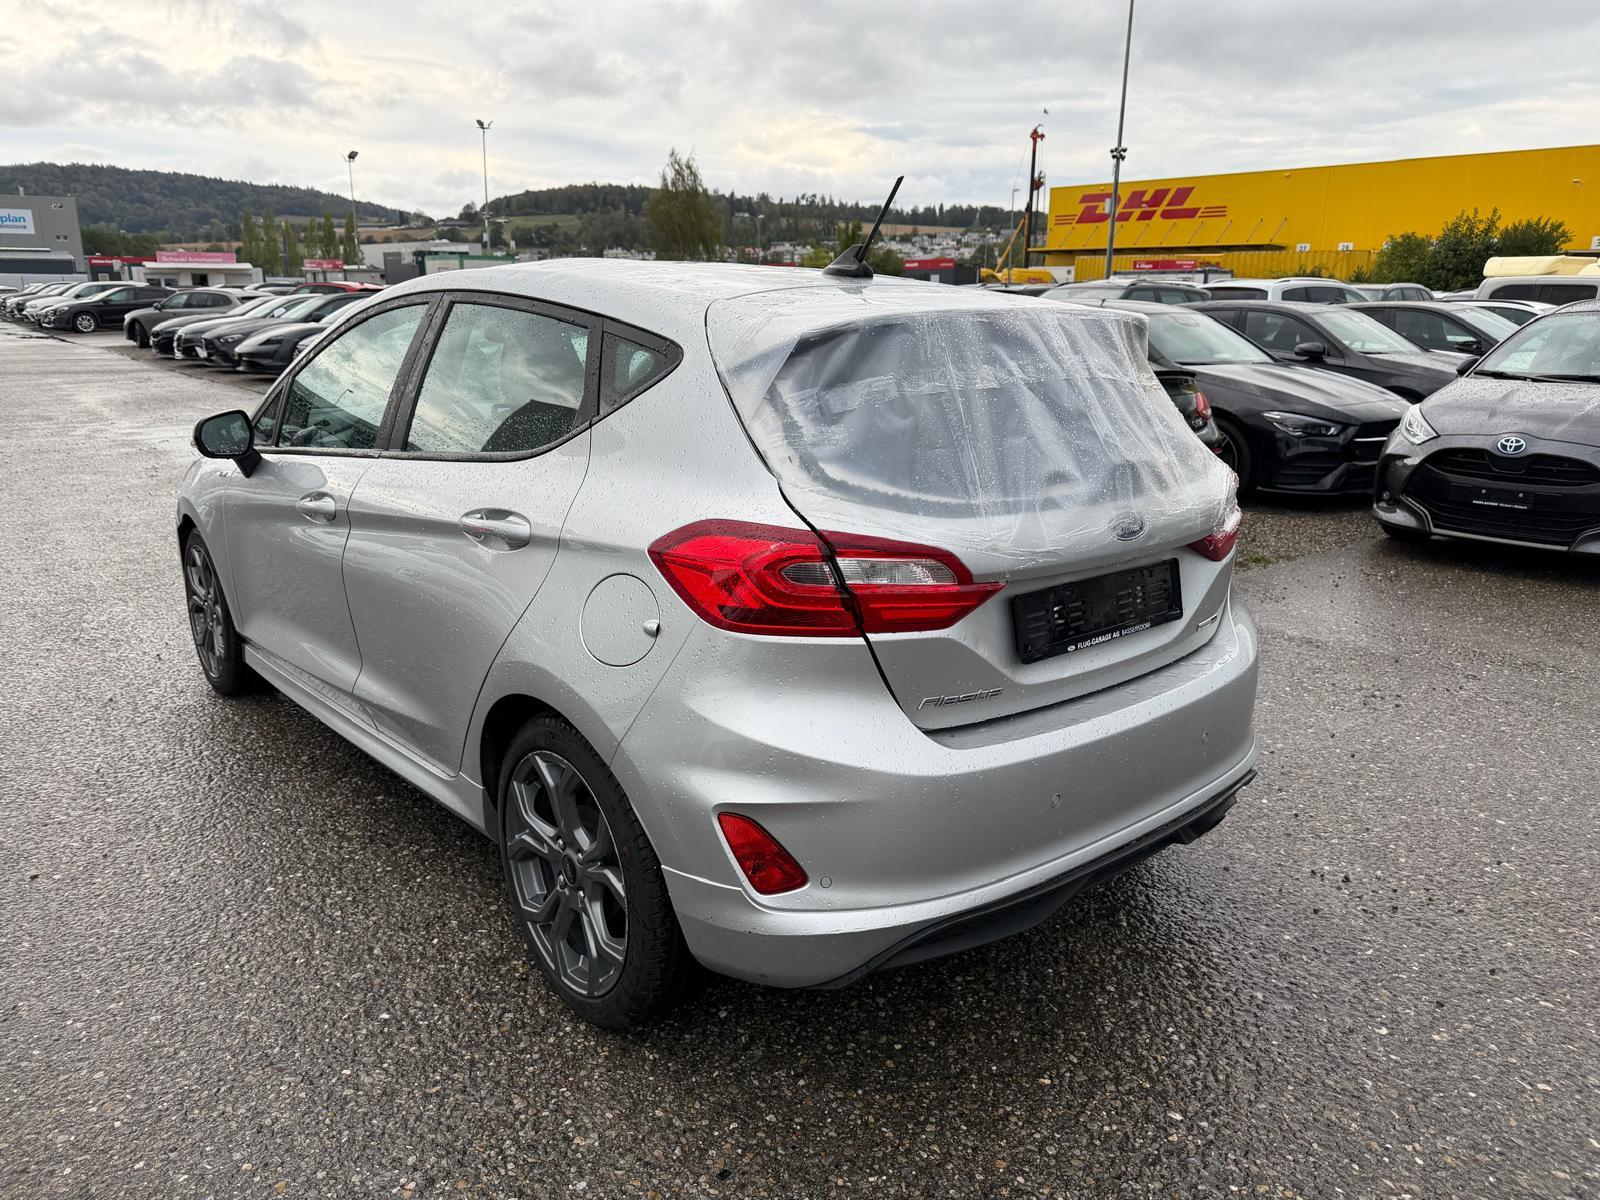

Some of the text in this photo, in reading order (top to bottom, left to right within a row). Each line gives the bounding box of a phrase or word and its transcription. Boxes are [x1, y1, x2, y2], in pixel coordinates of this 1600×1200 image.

[1075, 187, 1201, 224] DHL
[0, 214, 26, 224] plan
[1077, 632, 1112, 650] FLUG-GARAGE
[1112, 630, 1121, 639] AG
[1121, 622, 1151, 636] BASSERSDORF
[917, 687, 1004, 710] Fiesta
